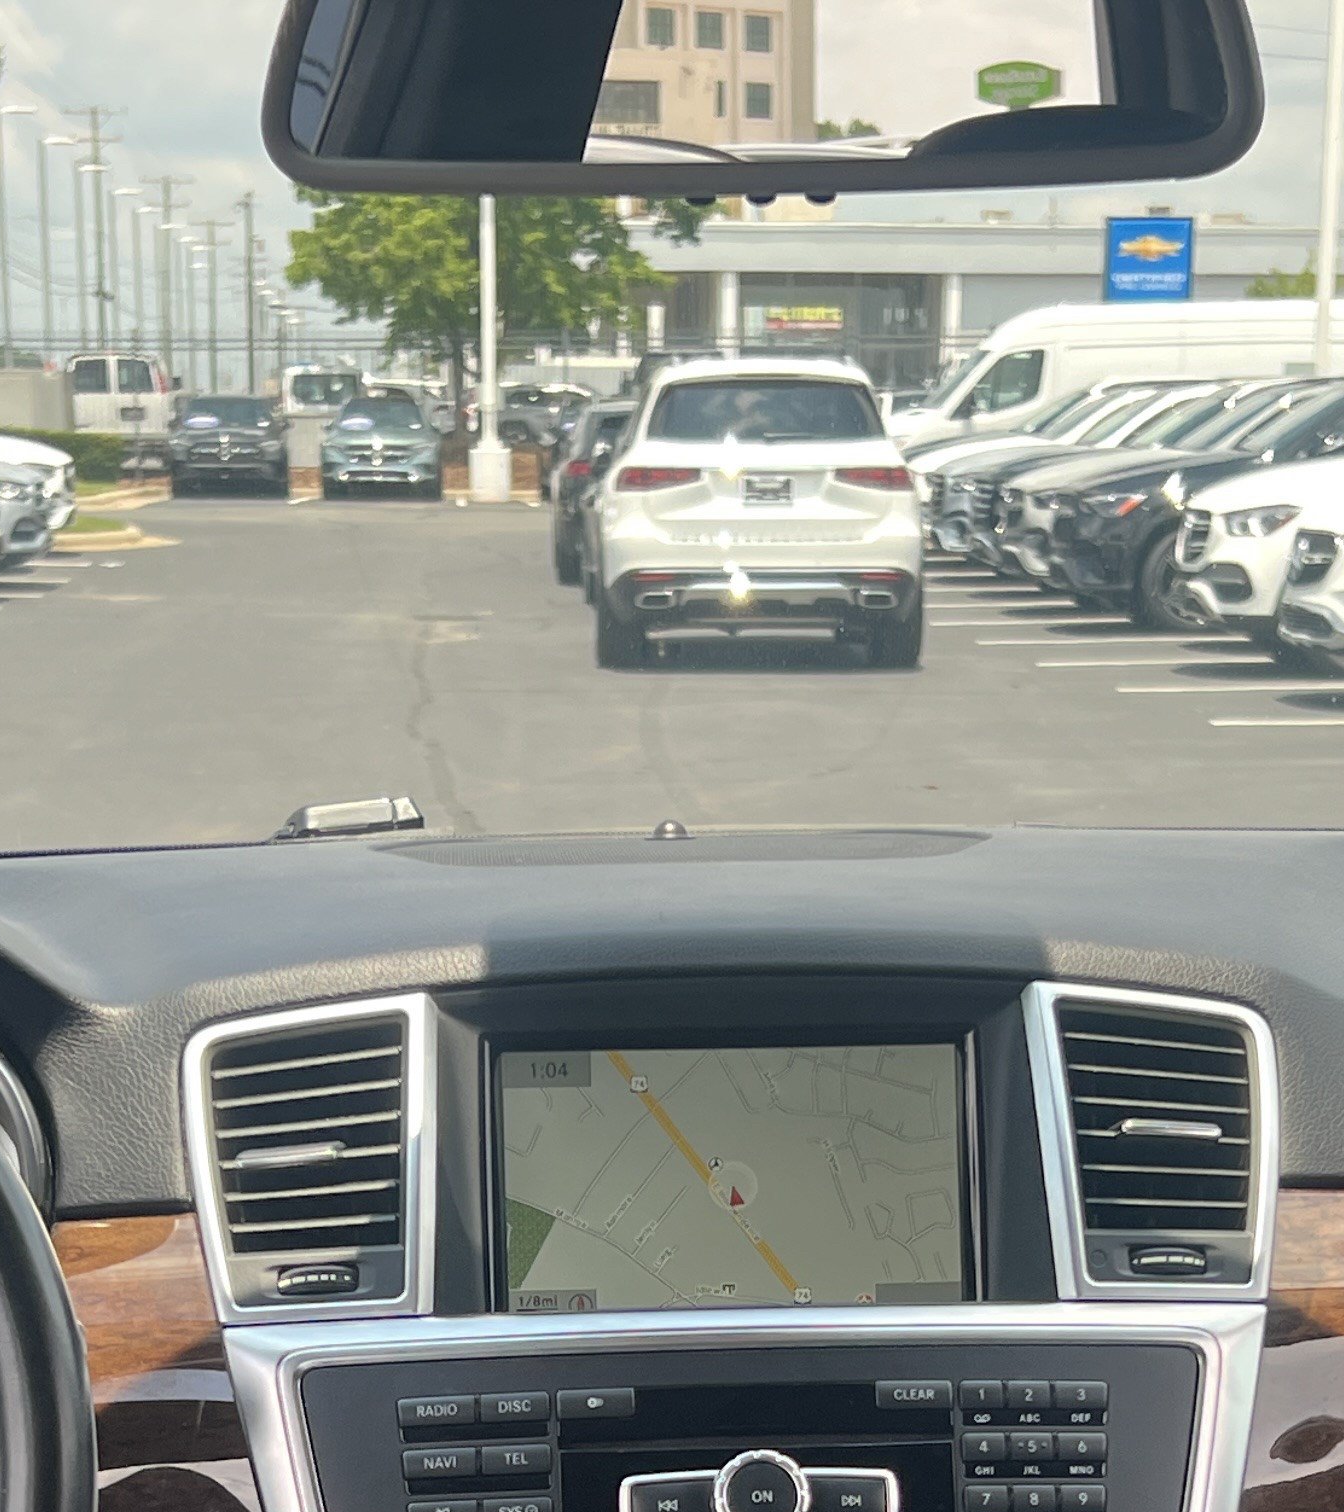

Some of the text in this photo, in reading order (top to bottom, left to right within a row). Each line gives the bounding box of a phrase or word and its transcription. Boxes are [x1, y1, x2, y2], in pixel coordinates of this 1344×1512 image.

[530, 1062, 568, 1079] 1:04
[892, 1388, 936, 1401] CLEAR
[978, 1388, 1086, 1402] 1 2 3
[415, 1400, 532, 1418] RADIO DISC
[1019, 1413, 1092, 1424] ABC DEF
[979, 1440, 1087, 1453] 4 5 6
[423, 1452, 529, 1471] NAVI TEL
[1022, 1465, 1042, 1476] JKL
[1069, 1464, 1094, 1476] MNO
[751, 1490, 774, 1503] ON
[981, 1492, 1088, 1506] 7 8 9
